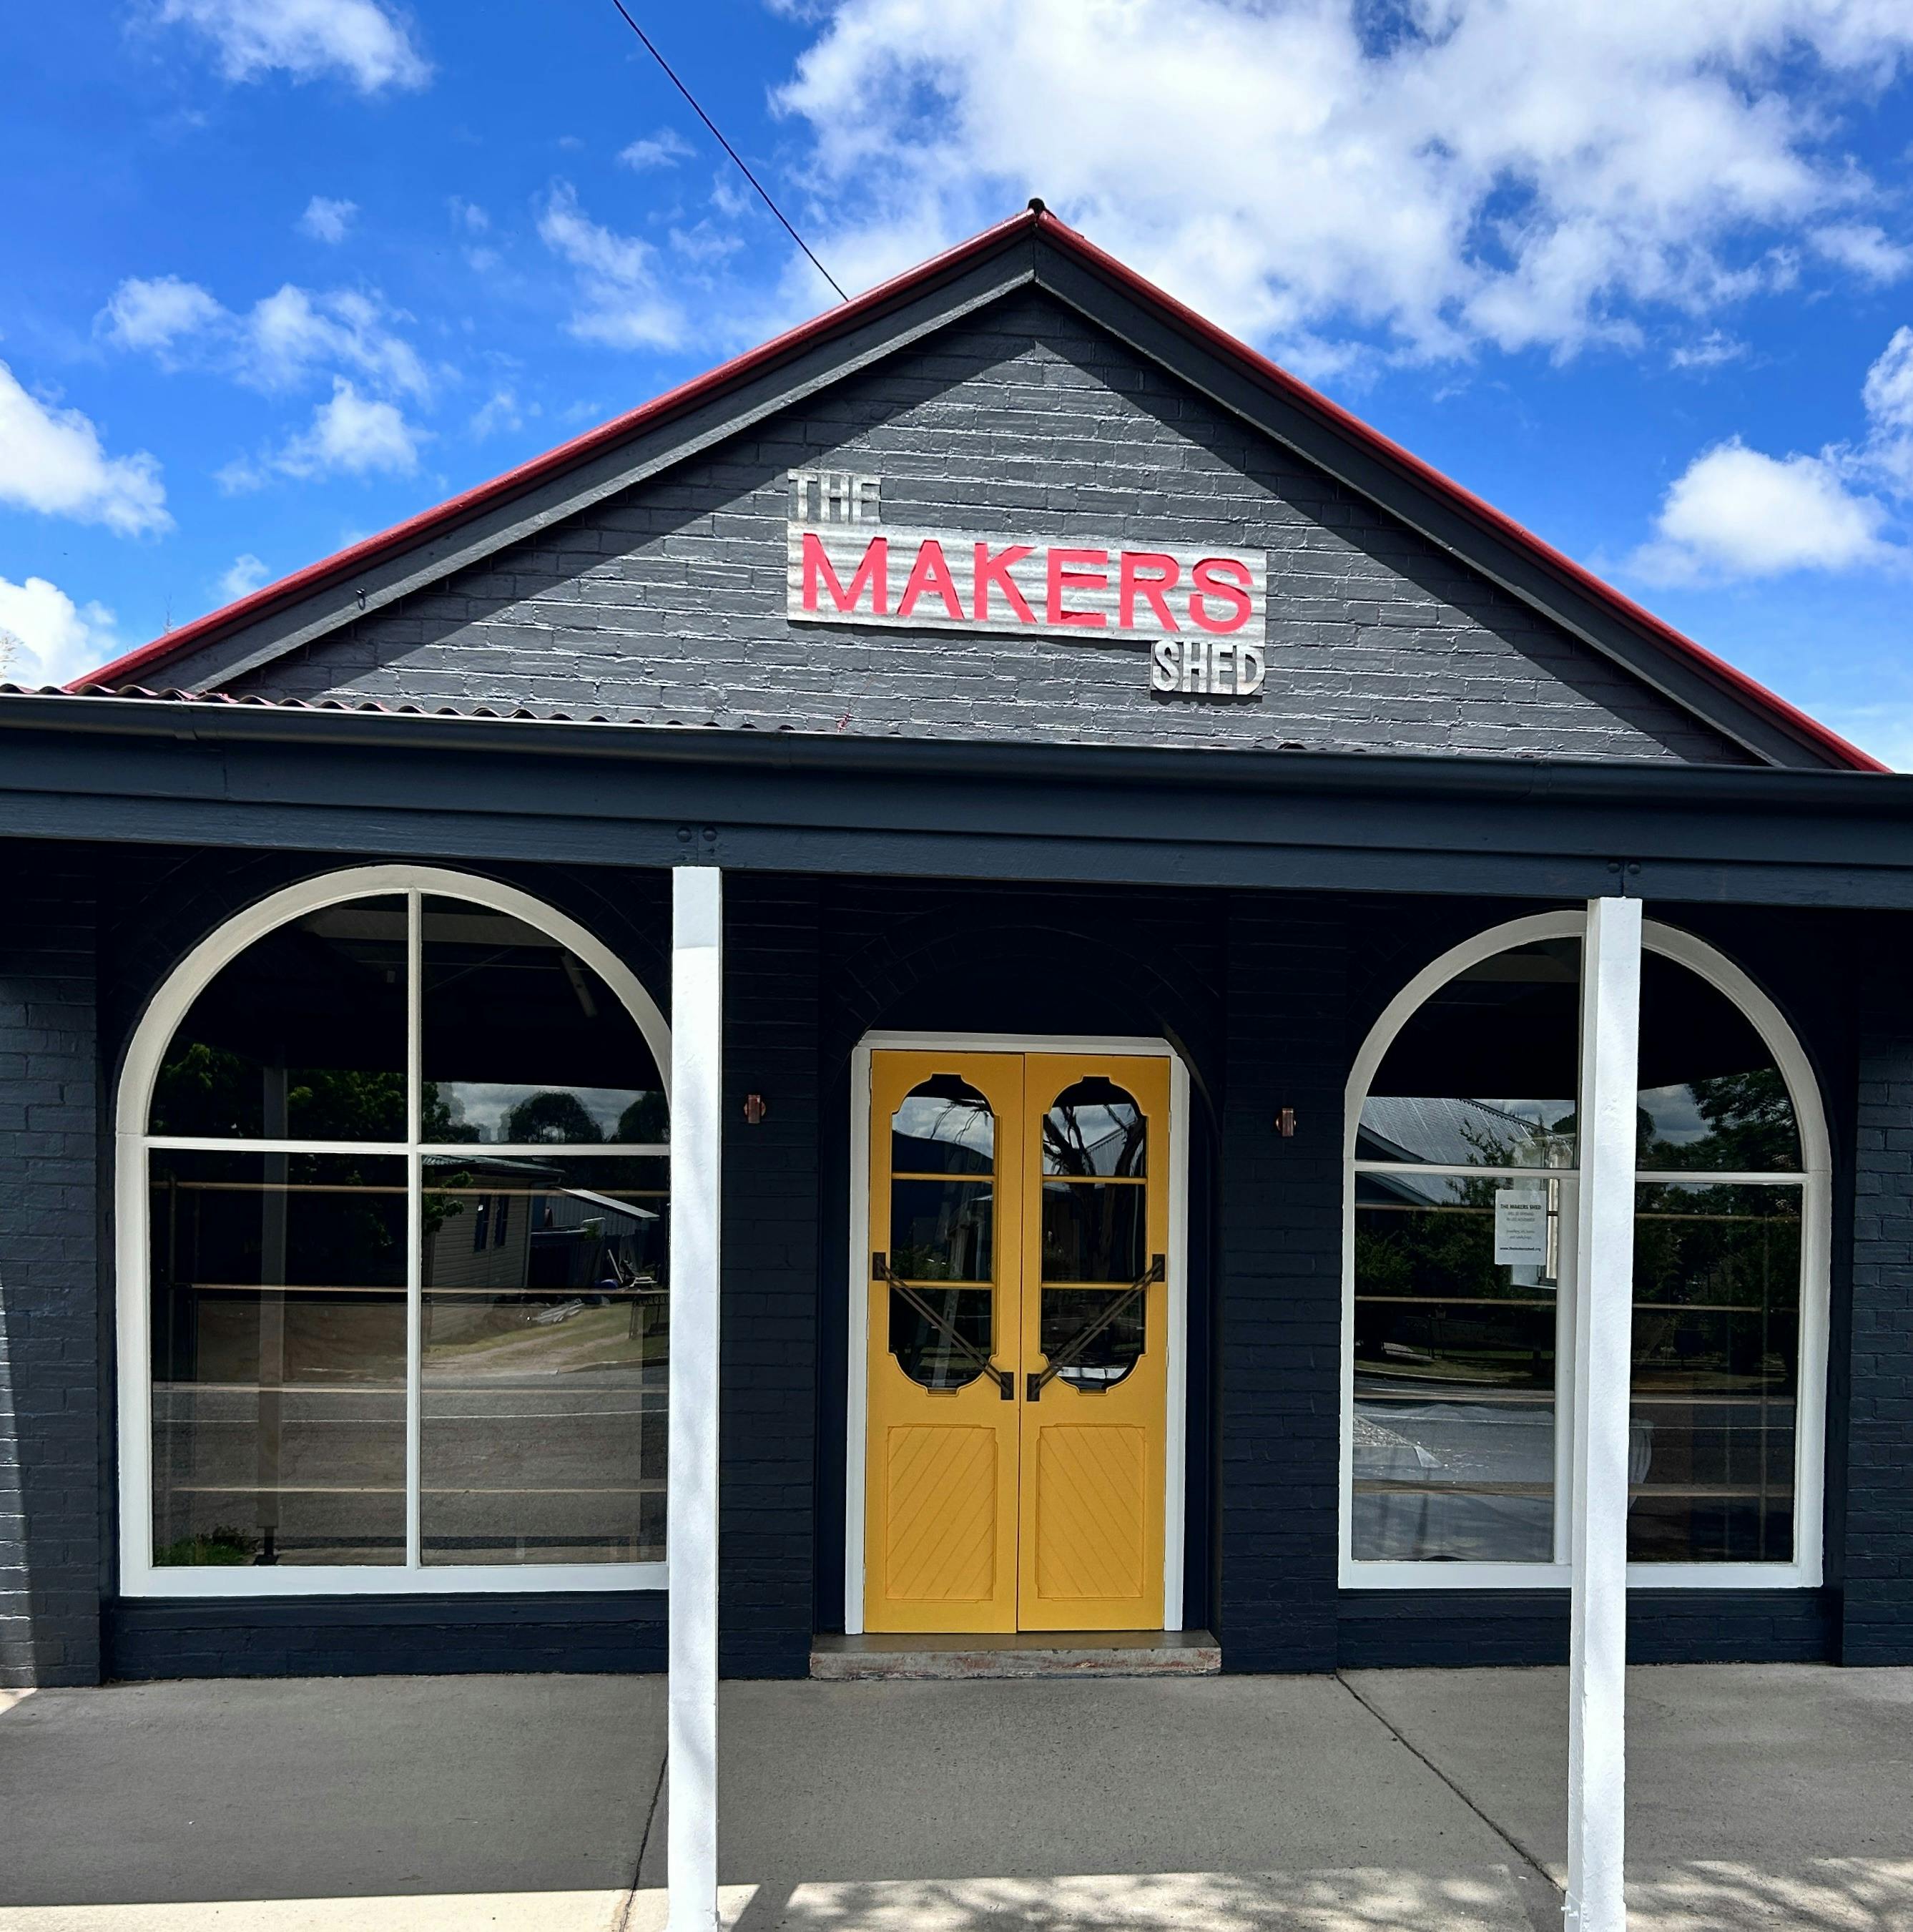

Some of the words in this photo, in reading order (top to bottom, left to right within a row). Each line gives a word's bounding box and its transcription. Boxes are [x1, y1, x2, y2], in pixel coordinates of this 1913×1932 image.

[787, 469, 881, 522] THE
[802, 533, 1253, 634] MAKERS
[1152, 640, 1265, 695] SHED
